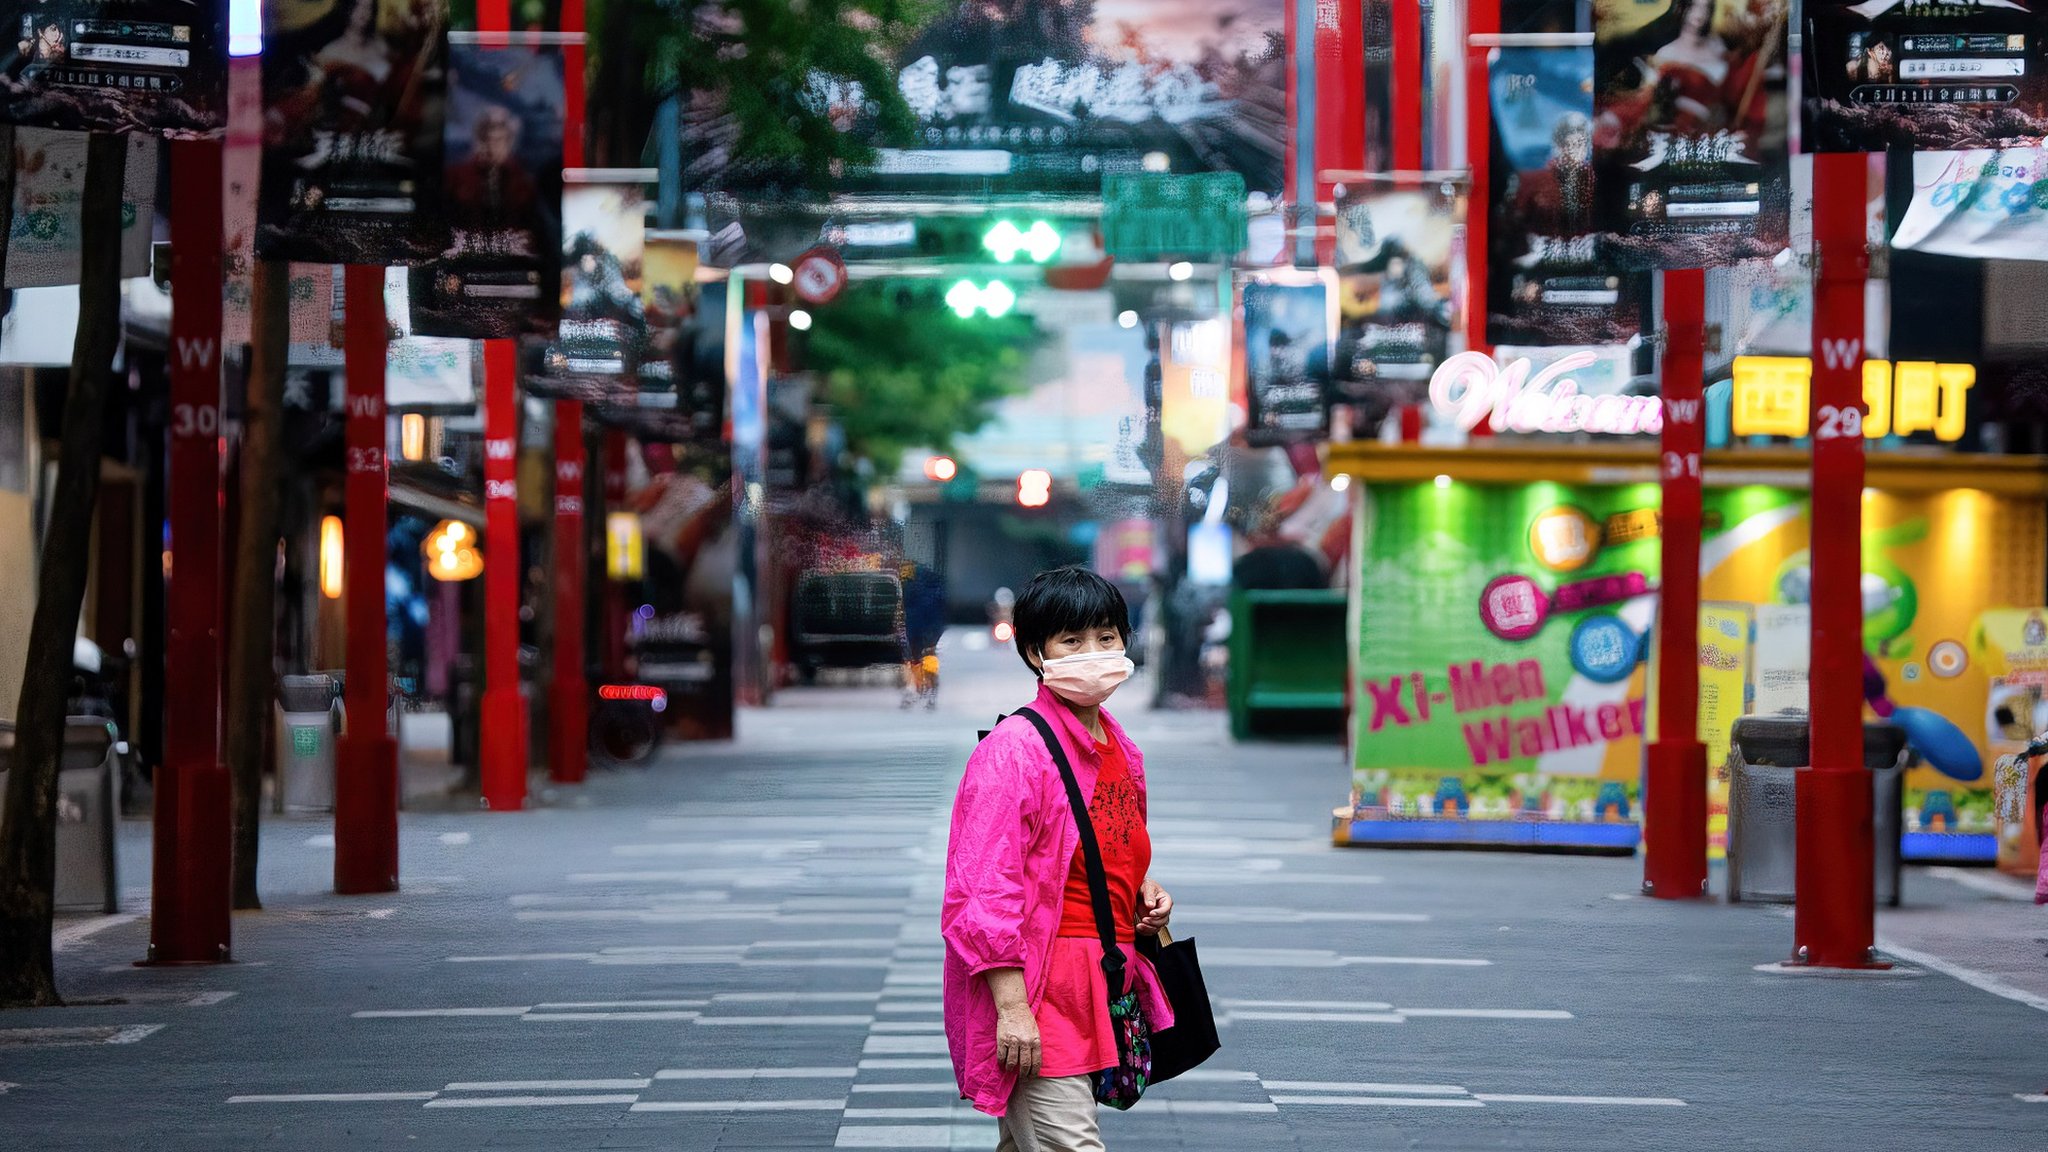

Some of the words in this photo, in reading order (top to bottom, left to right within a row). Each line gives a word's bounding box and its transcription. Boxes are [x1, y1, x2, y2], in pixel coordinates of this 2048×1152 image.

[176, 336, 216, 372] W
[1822, 338, 1861, 371] W
[174, 403, 218, 436] 30
[350, 394, 380, 417] W
[1665, 399, 1699, 424] W
[1816, 405, 1862, 440] 29
[1663, 451, 1700, 478] 31
[1364, 659, 1546, 732] Xi-Men
[1463, 699, 1646, 766] Walker
